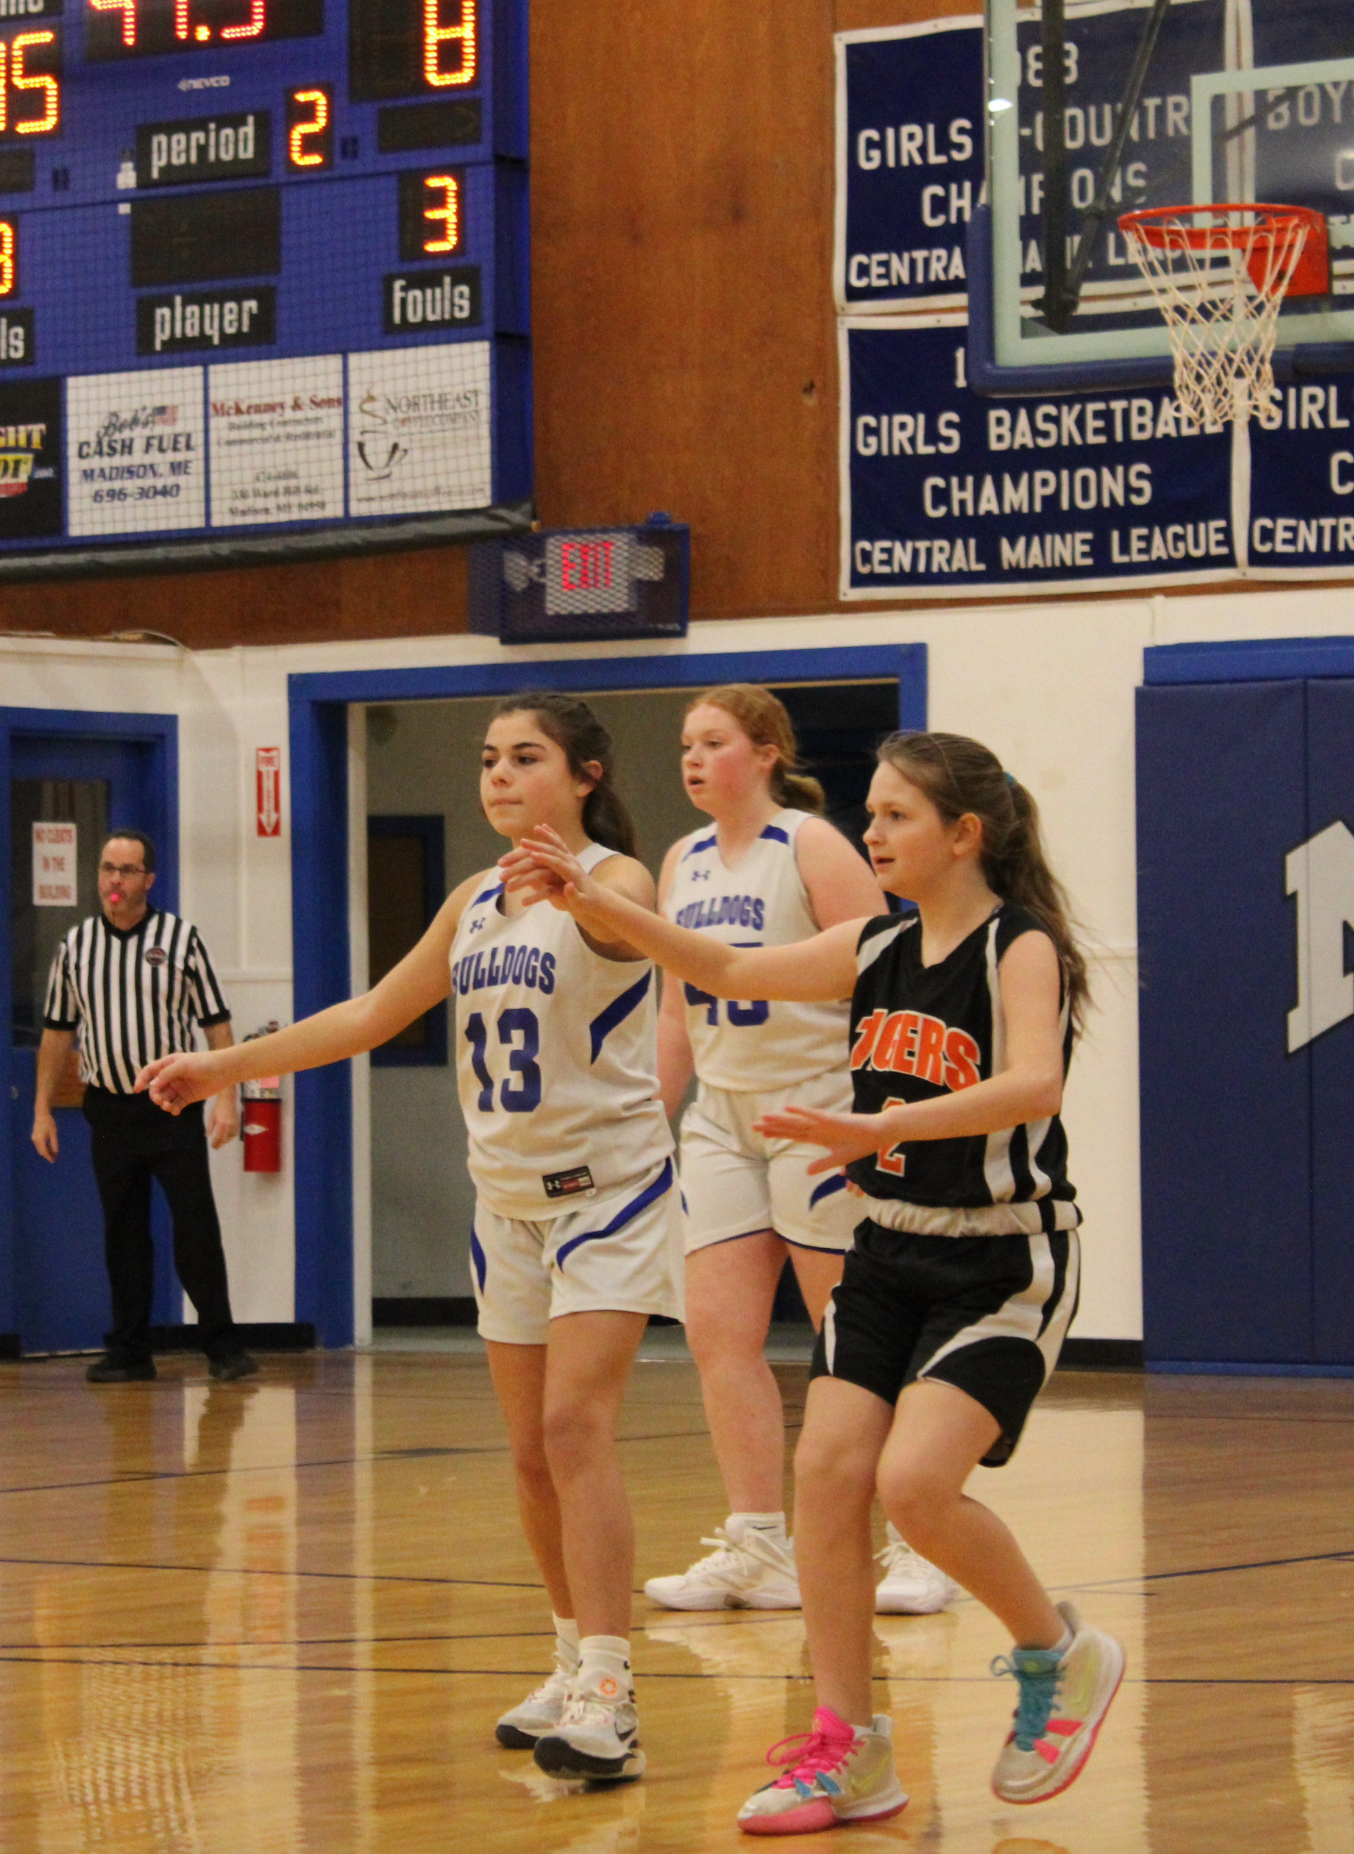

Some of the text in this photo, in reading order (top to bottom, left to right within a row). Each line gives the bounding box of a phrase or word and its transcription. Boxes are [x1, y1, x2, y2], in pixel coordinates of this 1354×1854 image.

[151, 115, 255, 178] period
[290, 90, 328, 166] 2
[857, 119, 973, 171] GIRLS
[423, 175, 458, 252] 3
[154, 295, 258, 351] player
[393, 276, 471, 324] fouls
[77, 438, 134, 460] CASH
[144, 432, 195, 454] FUEL
[856, 395, 1224, 456] GIRLS BASKETBALL
[169, 460, 193, 476] ME
[922, 463, 1153, 518] CHAMPIONS
[561, 541, 614, 591] EXIT
[854, 519, 1229, 574] CENTRAL MAINE LEAGUE
[676, 894, 764, 932] BULLDOGS
[465, 1008, 541, 1113] 13
